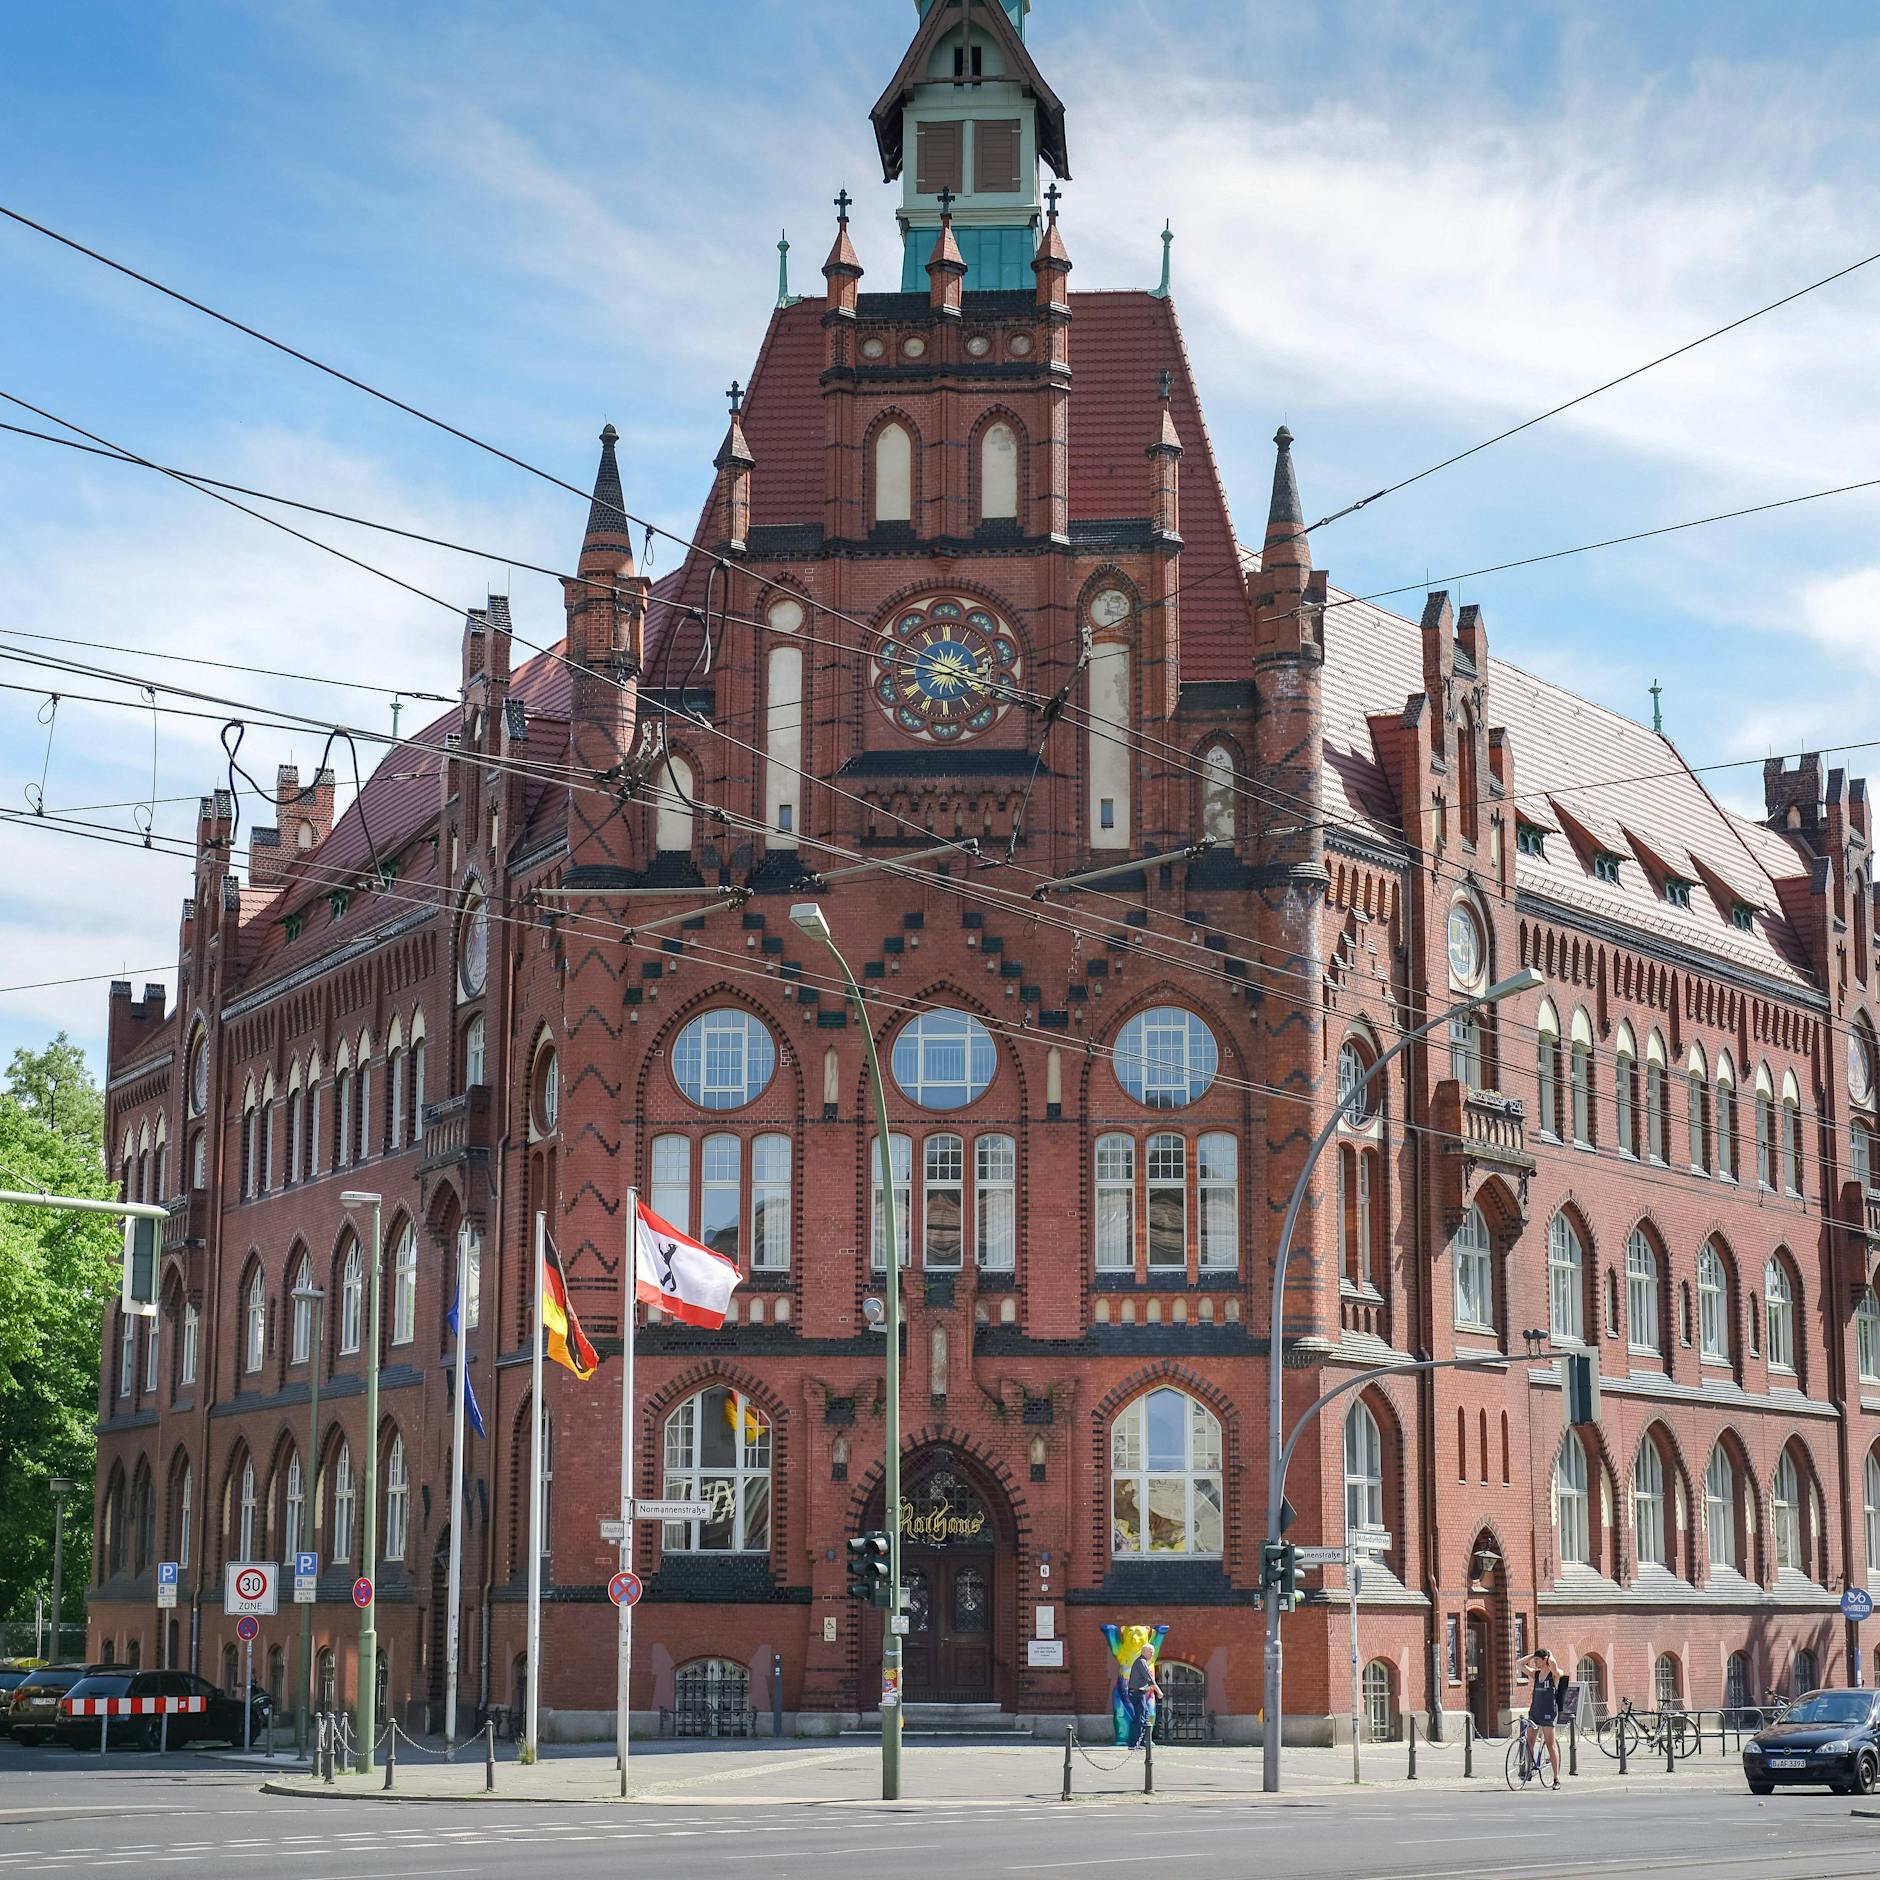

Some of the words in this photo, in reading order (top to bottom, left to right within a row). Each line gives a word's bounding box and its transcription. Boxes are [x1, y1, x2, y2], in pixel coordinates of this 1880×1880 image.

[639, 1505, 706, 1515] Normannenstraße
[900, 1496, 985, 1542] Rathaus
[1304, 1552, 1341, 1560] nenstraße
[300, 1555, 313, 1573] P
[162, 1565, 174, 1582] P
[242, 1577, 261, 1592] 30
[238, 1602, 263, 1611] ZONE
